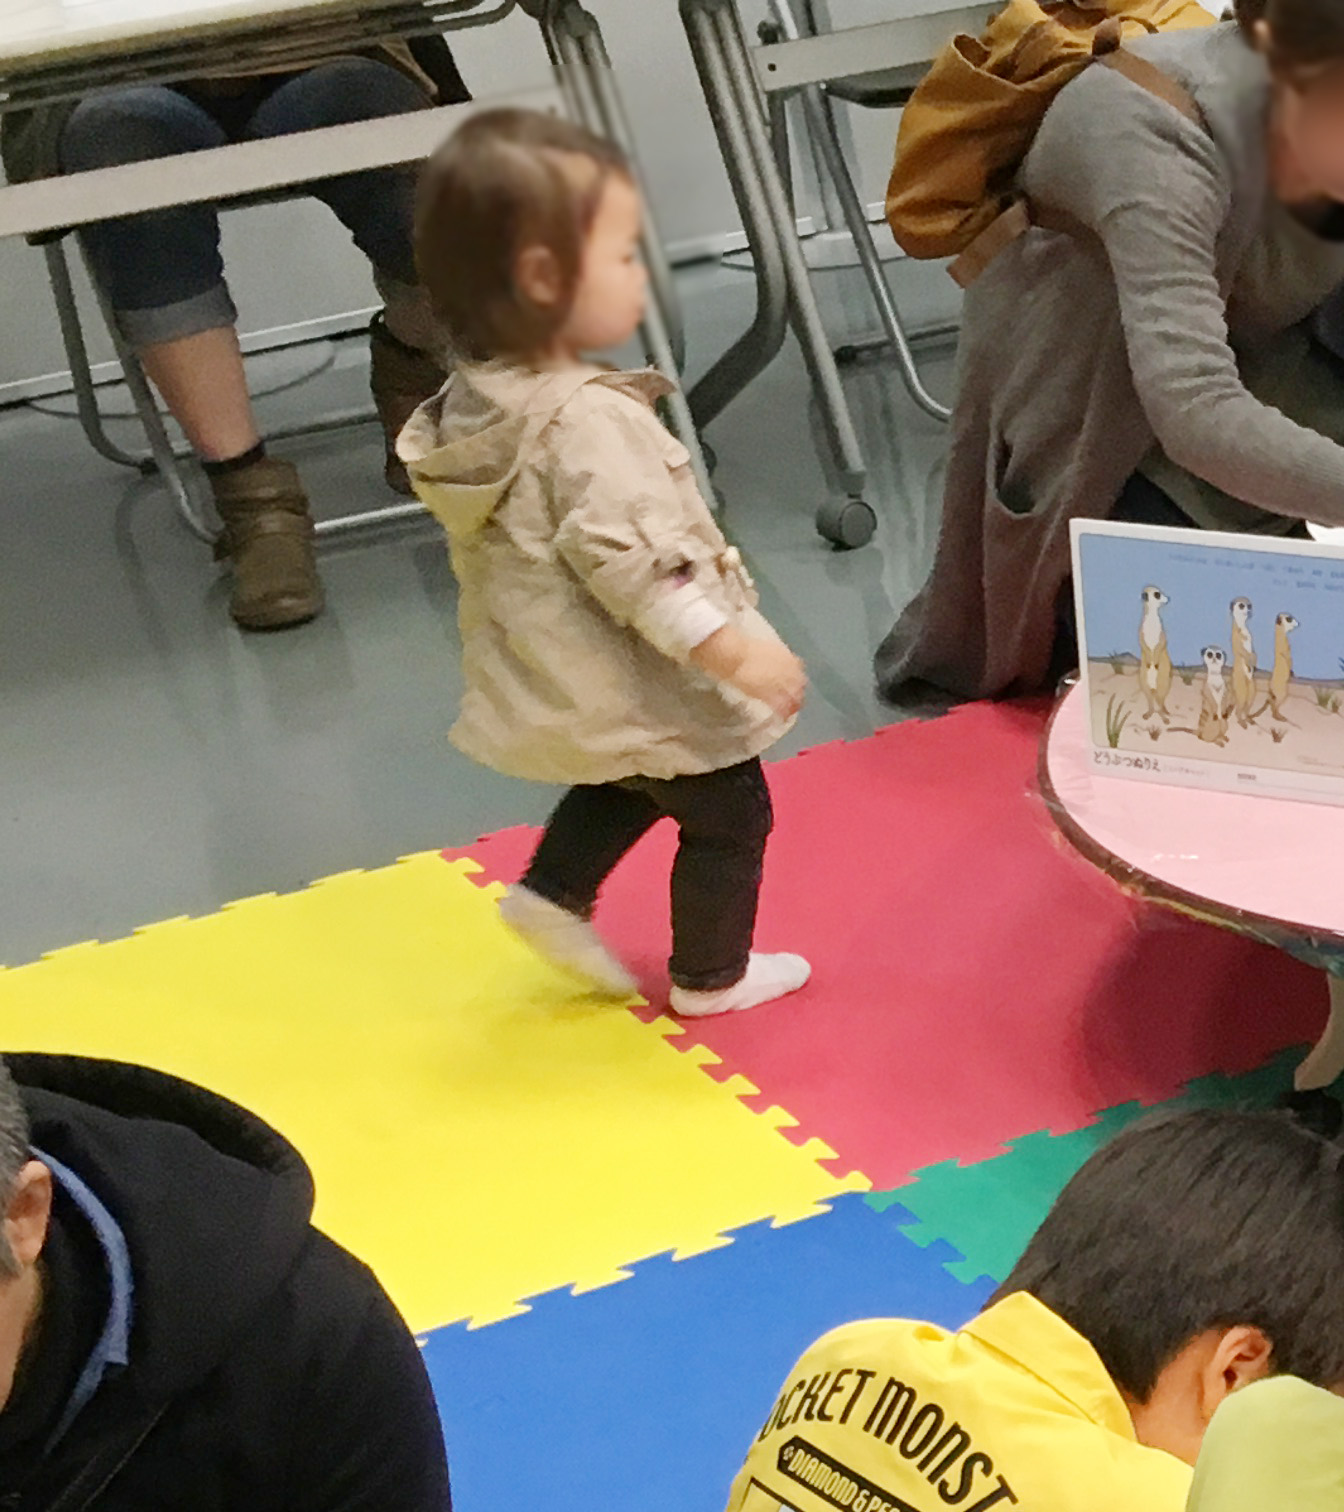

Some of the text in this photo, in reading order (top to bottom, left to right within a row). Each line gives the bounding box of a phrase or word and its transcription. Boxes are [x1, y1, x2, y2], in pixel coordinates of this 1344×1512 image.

[1093, 750, 1162, 772] どうぶつぬりえ
[757, 1367, 877, 1442] OCKET
